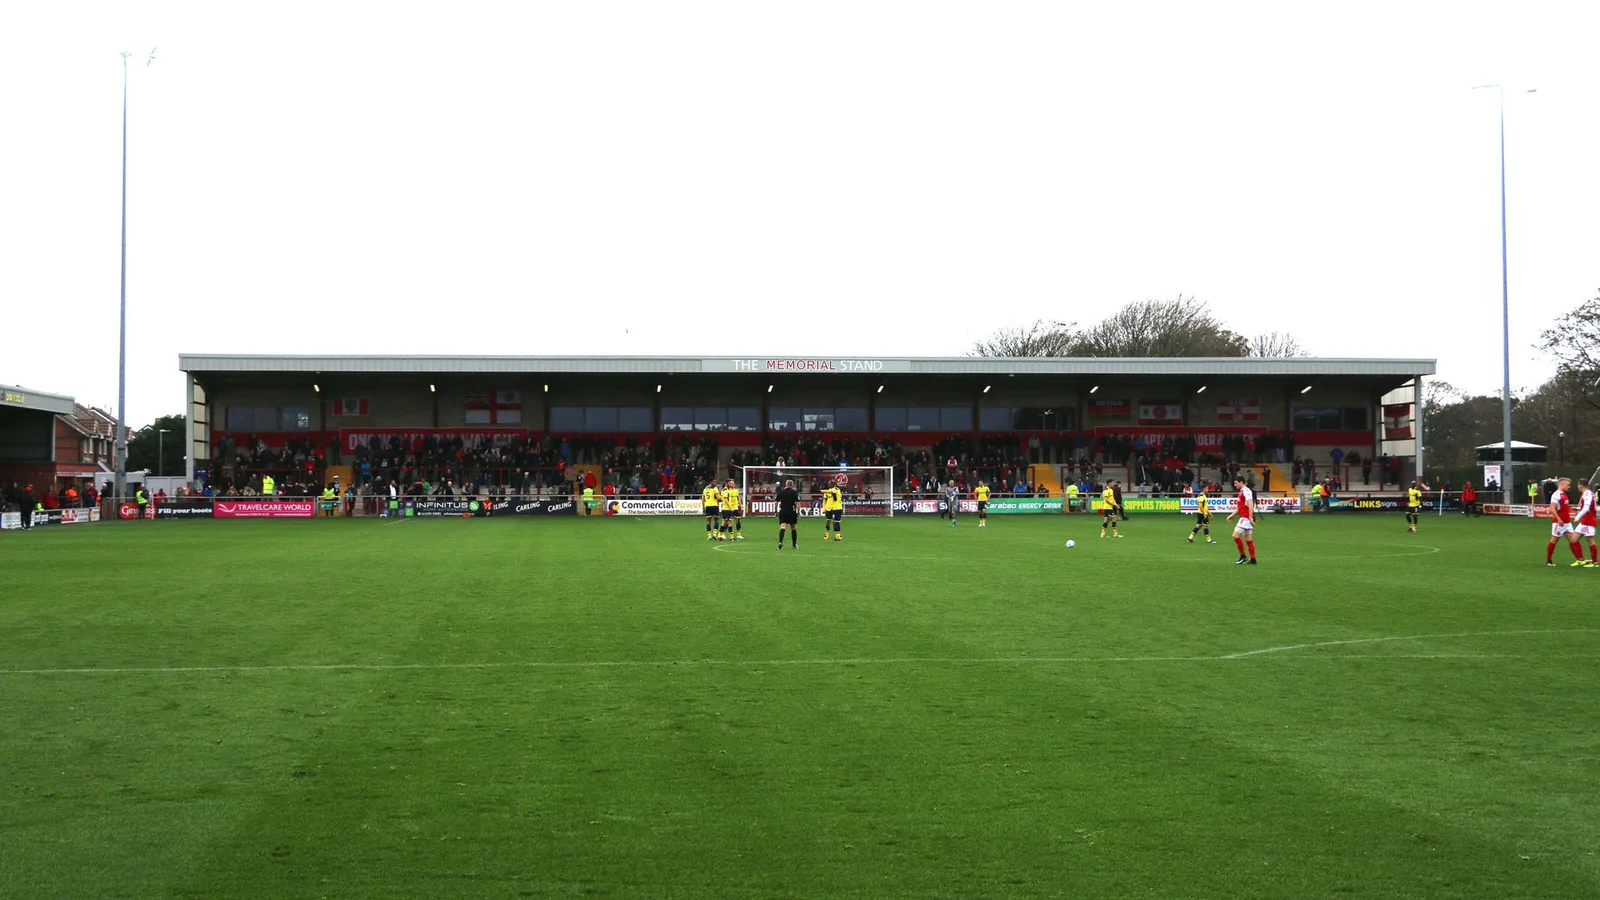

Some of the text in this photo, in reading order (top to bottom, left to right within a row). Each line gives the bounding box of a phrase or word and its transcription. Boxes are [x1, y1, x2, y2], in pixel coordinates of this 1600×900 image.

[732, 360, 888, 371] THE MEMORIAL STAND
[515, 501, 541, 512] CARLING
[547, 501, 572, 512] CARLING
[621, 501, 674, 509] Commercial
[893, 501, 911, 512] sky
[1123, 501, 1180, 510] SUPPLIES 776600
